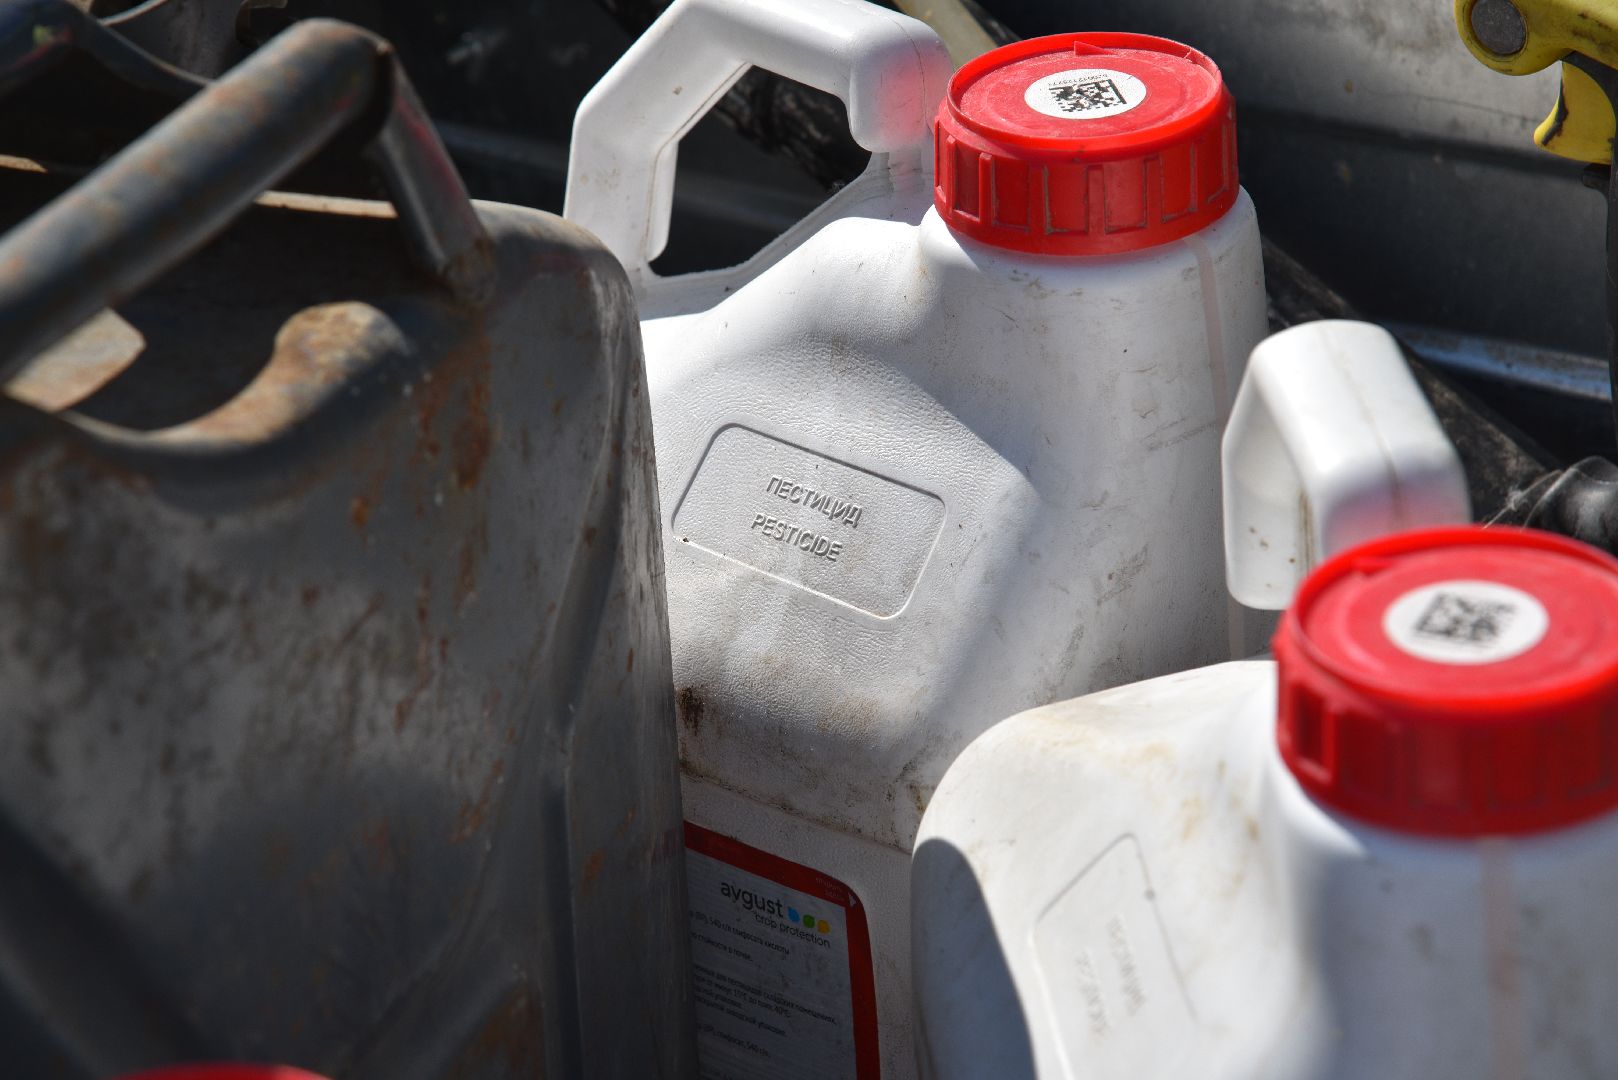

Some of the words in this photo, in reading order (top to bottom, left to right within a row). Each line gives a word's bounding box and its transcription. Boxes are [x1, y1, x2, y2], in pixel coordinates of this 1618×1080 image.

[766, 475, 863, 529] ПЕСТИЦИД
[751, 513, 843, 562] PESTICIDE
[720, 881, 785, 918] avgust
[755, 912, 777, 930] crop
[779, 920, 831, 948] protection
